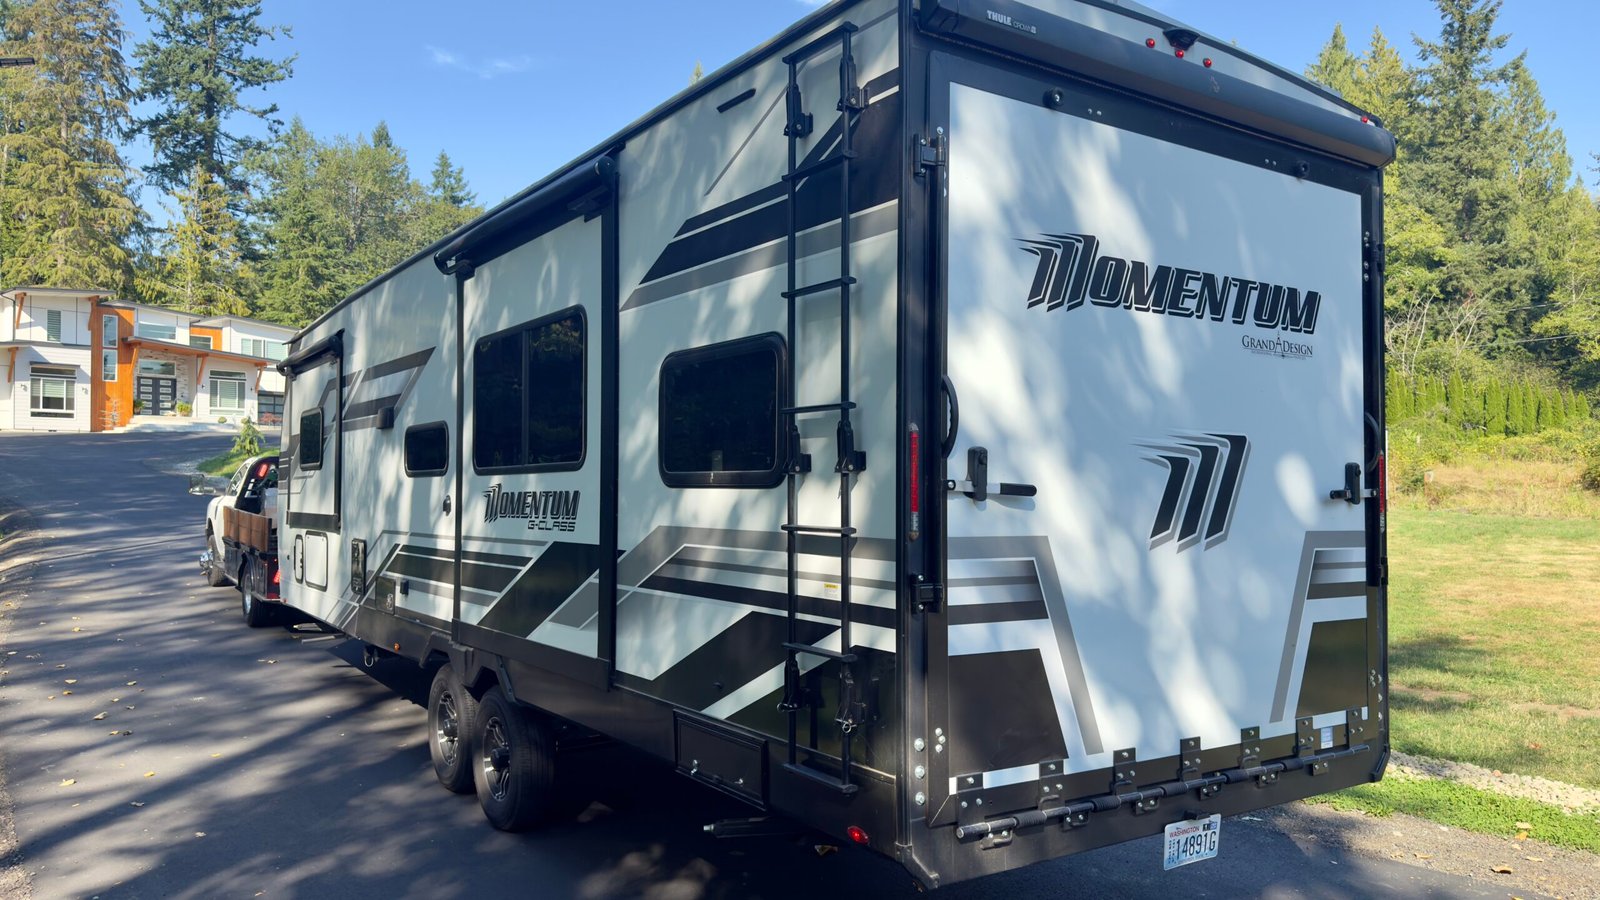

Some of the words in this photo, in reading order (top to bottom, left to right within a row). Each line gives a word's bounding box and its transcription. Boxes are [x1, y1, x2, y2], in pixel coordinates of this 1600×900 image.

[987, 9, 1012, 26] THULE
[1014, 232, 1321, 335] MOMENTUM
[1241, 334, 1276, 351] GRAND
[1282, 340, 1313, 356] DESIGN
[483, 483, 581, 523] MOMENTUM
[1169, 825, 1200, 838] WASHINGTON
[1176, 831, 1217, 860] 14891G
